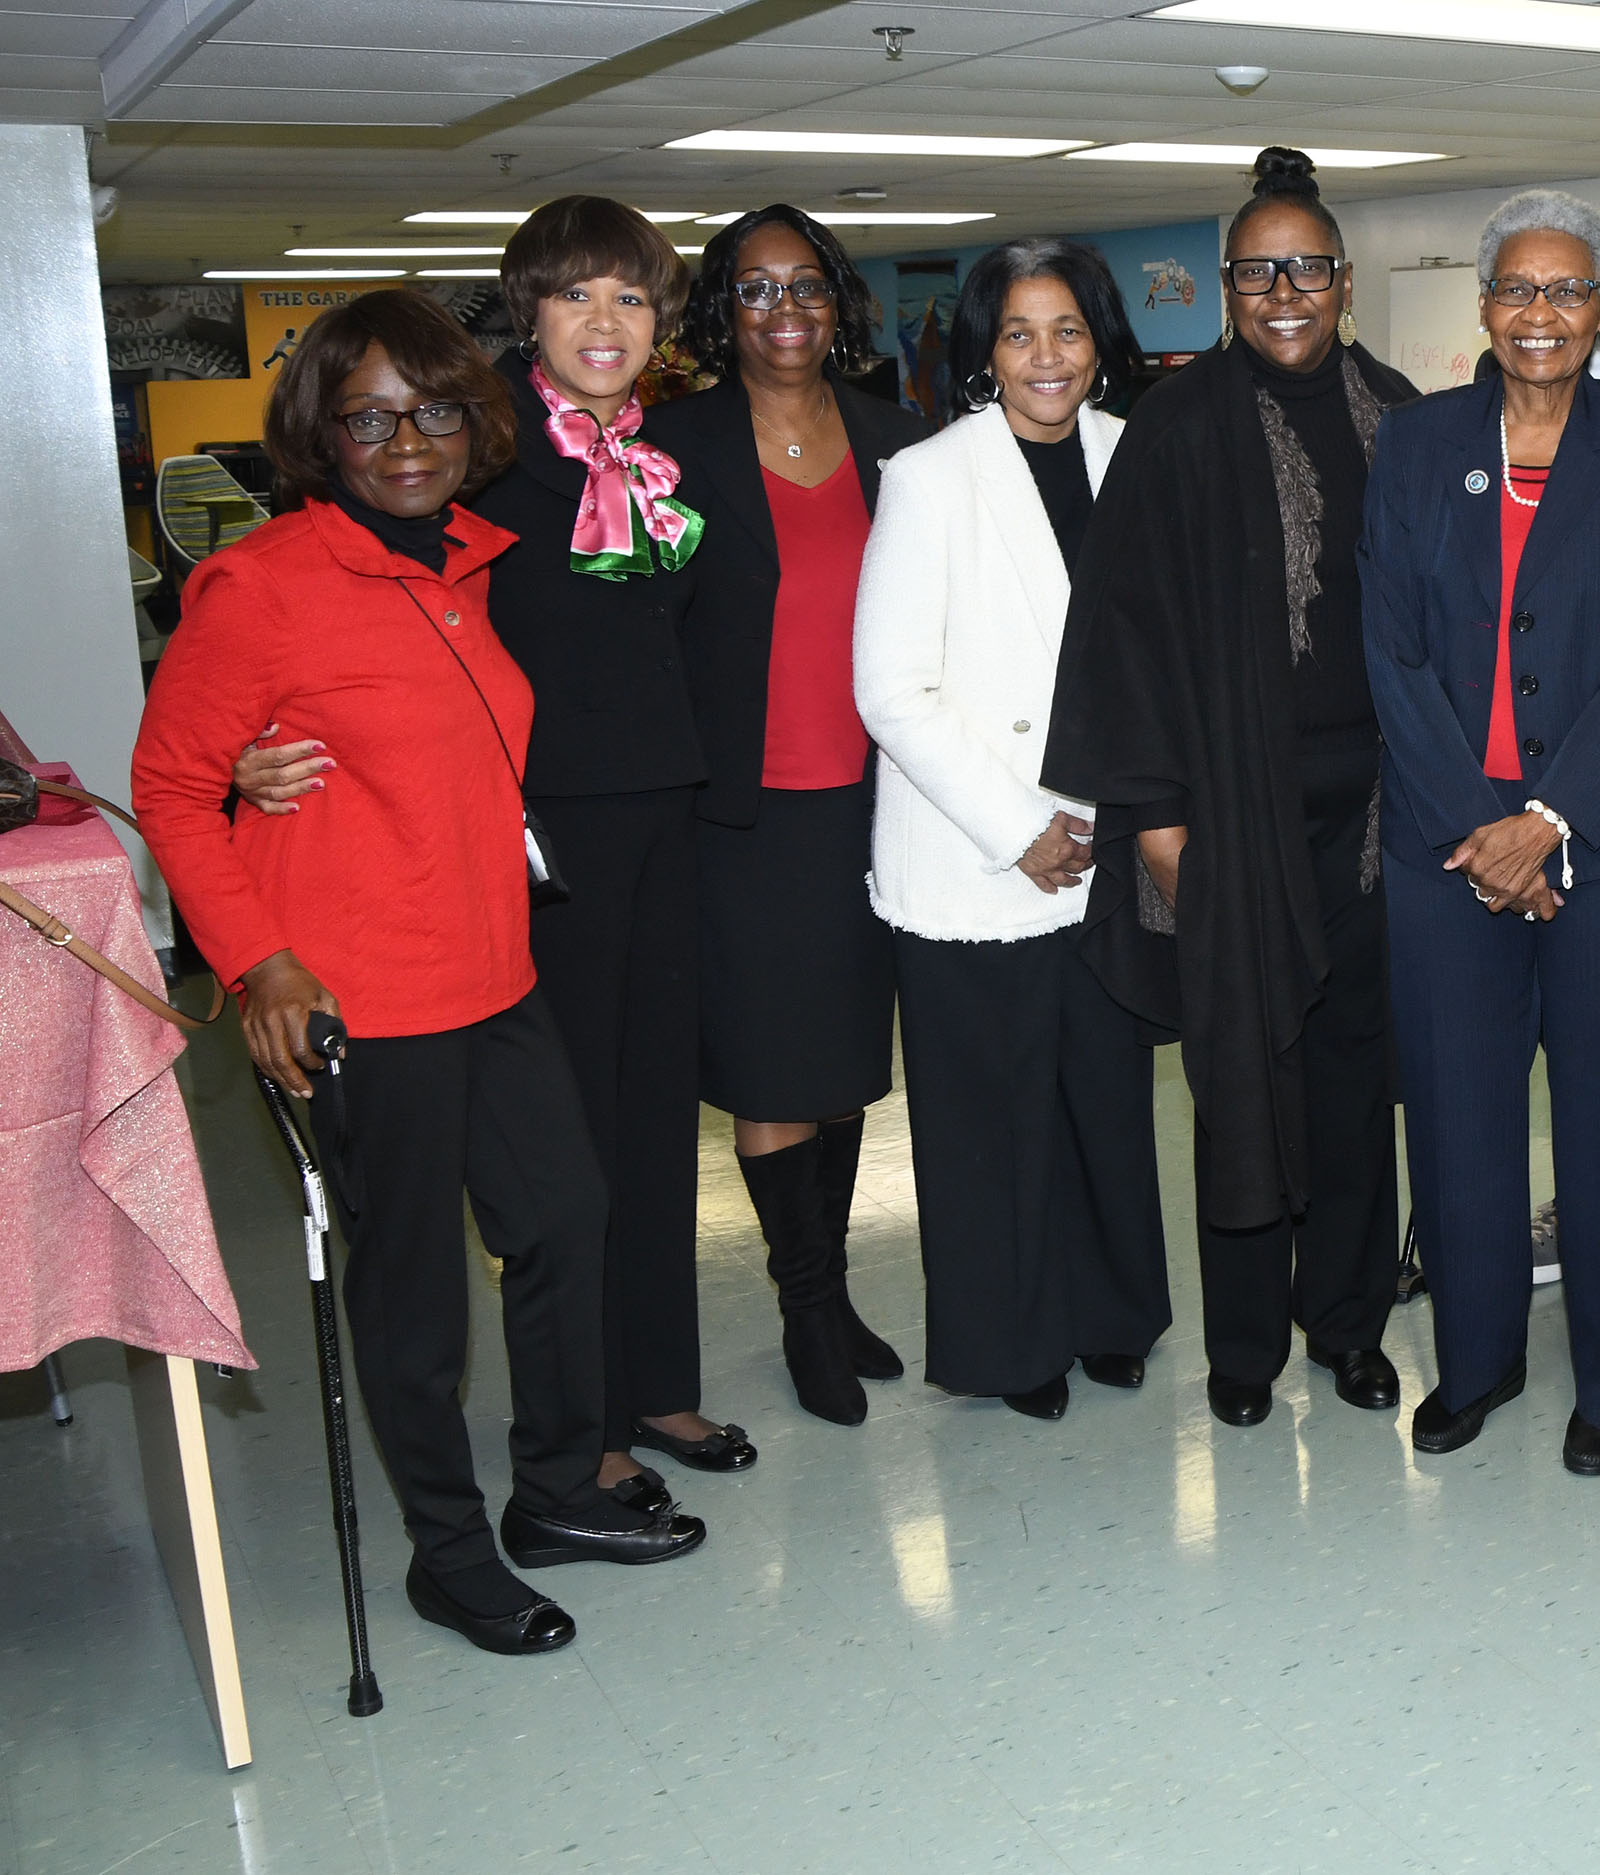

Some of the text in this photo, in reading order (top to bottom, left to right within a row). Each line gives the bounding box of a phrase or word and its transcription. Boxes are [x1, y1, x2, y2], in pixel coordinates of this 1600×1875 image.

[260, 291, 363, 306] THE GARA
[109, 345, 231, 378] VELOPMENT
